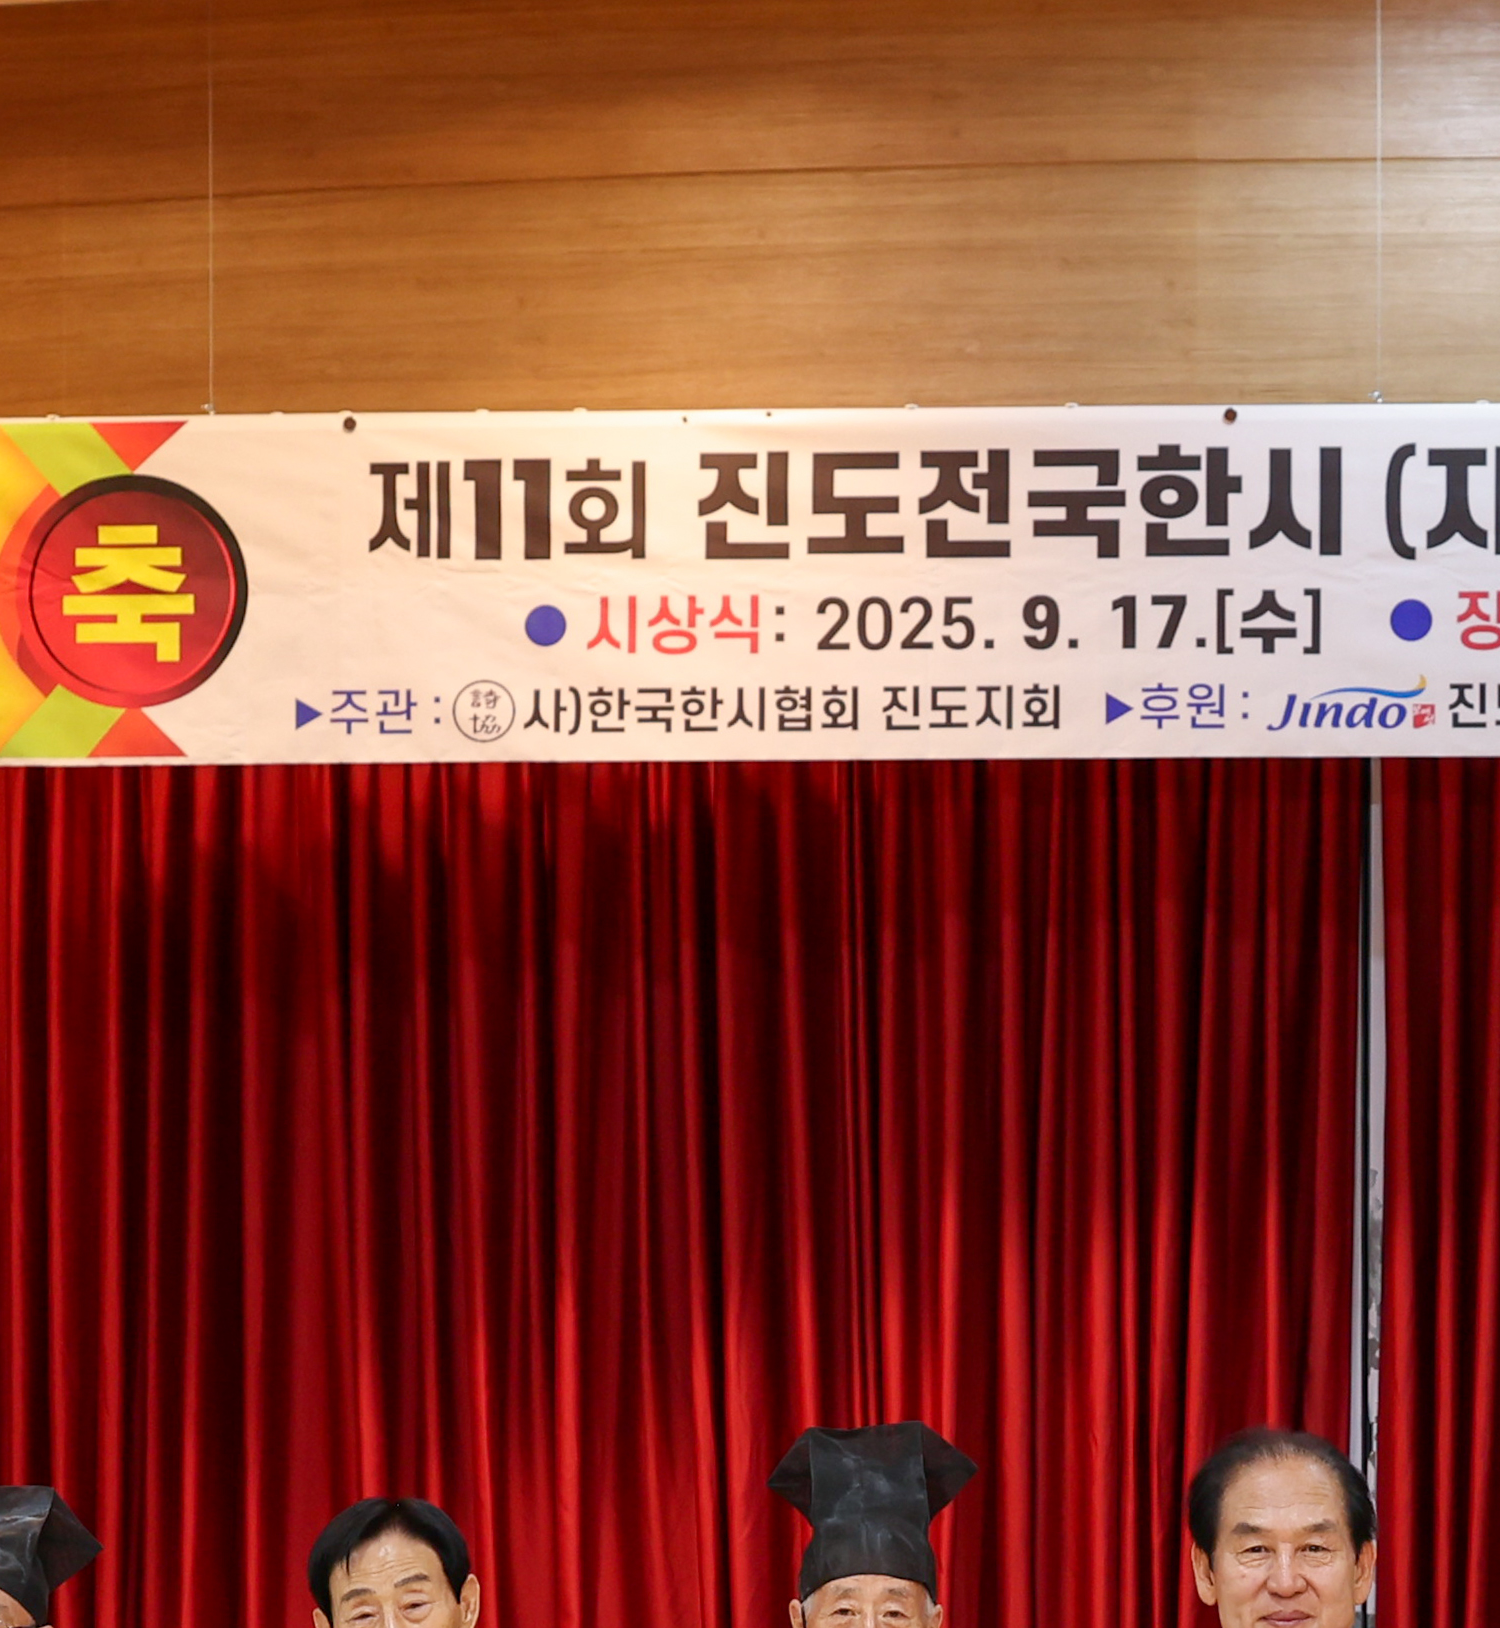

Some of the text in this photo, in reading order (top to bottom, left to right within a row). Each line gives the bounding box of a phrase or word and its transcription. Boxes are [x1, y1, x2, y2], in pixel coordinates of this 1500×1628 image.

[369, 459, 646, 560] 제11회
[698, 444, 1342, 560] 진도전국한시
[63, 525, 194, 662] 축
[587, 595, 784, 654] 시상식:
[817, 596, 994, 650] 2025.
[1023, 595, 1078, 650] 9.
[524, 685, 858, 736] 사)한국한시협회
[883, 684, 1060, 731] 진도지회
[1267, 693, 1407, 731] Jindo
